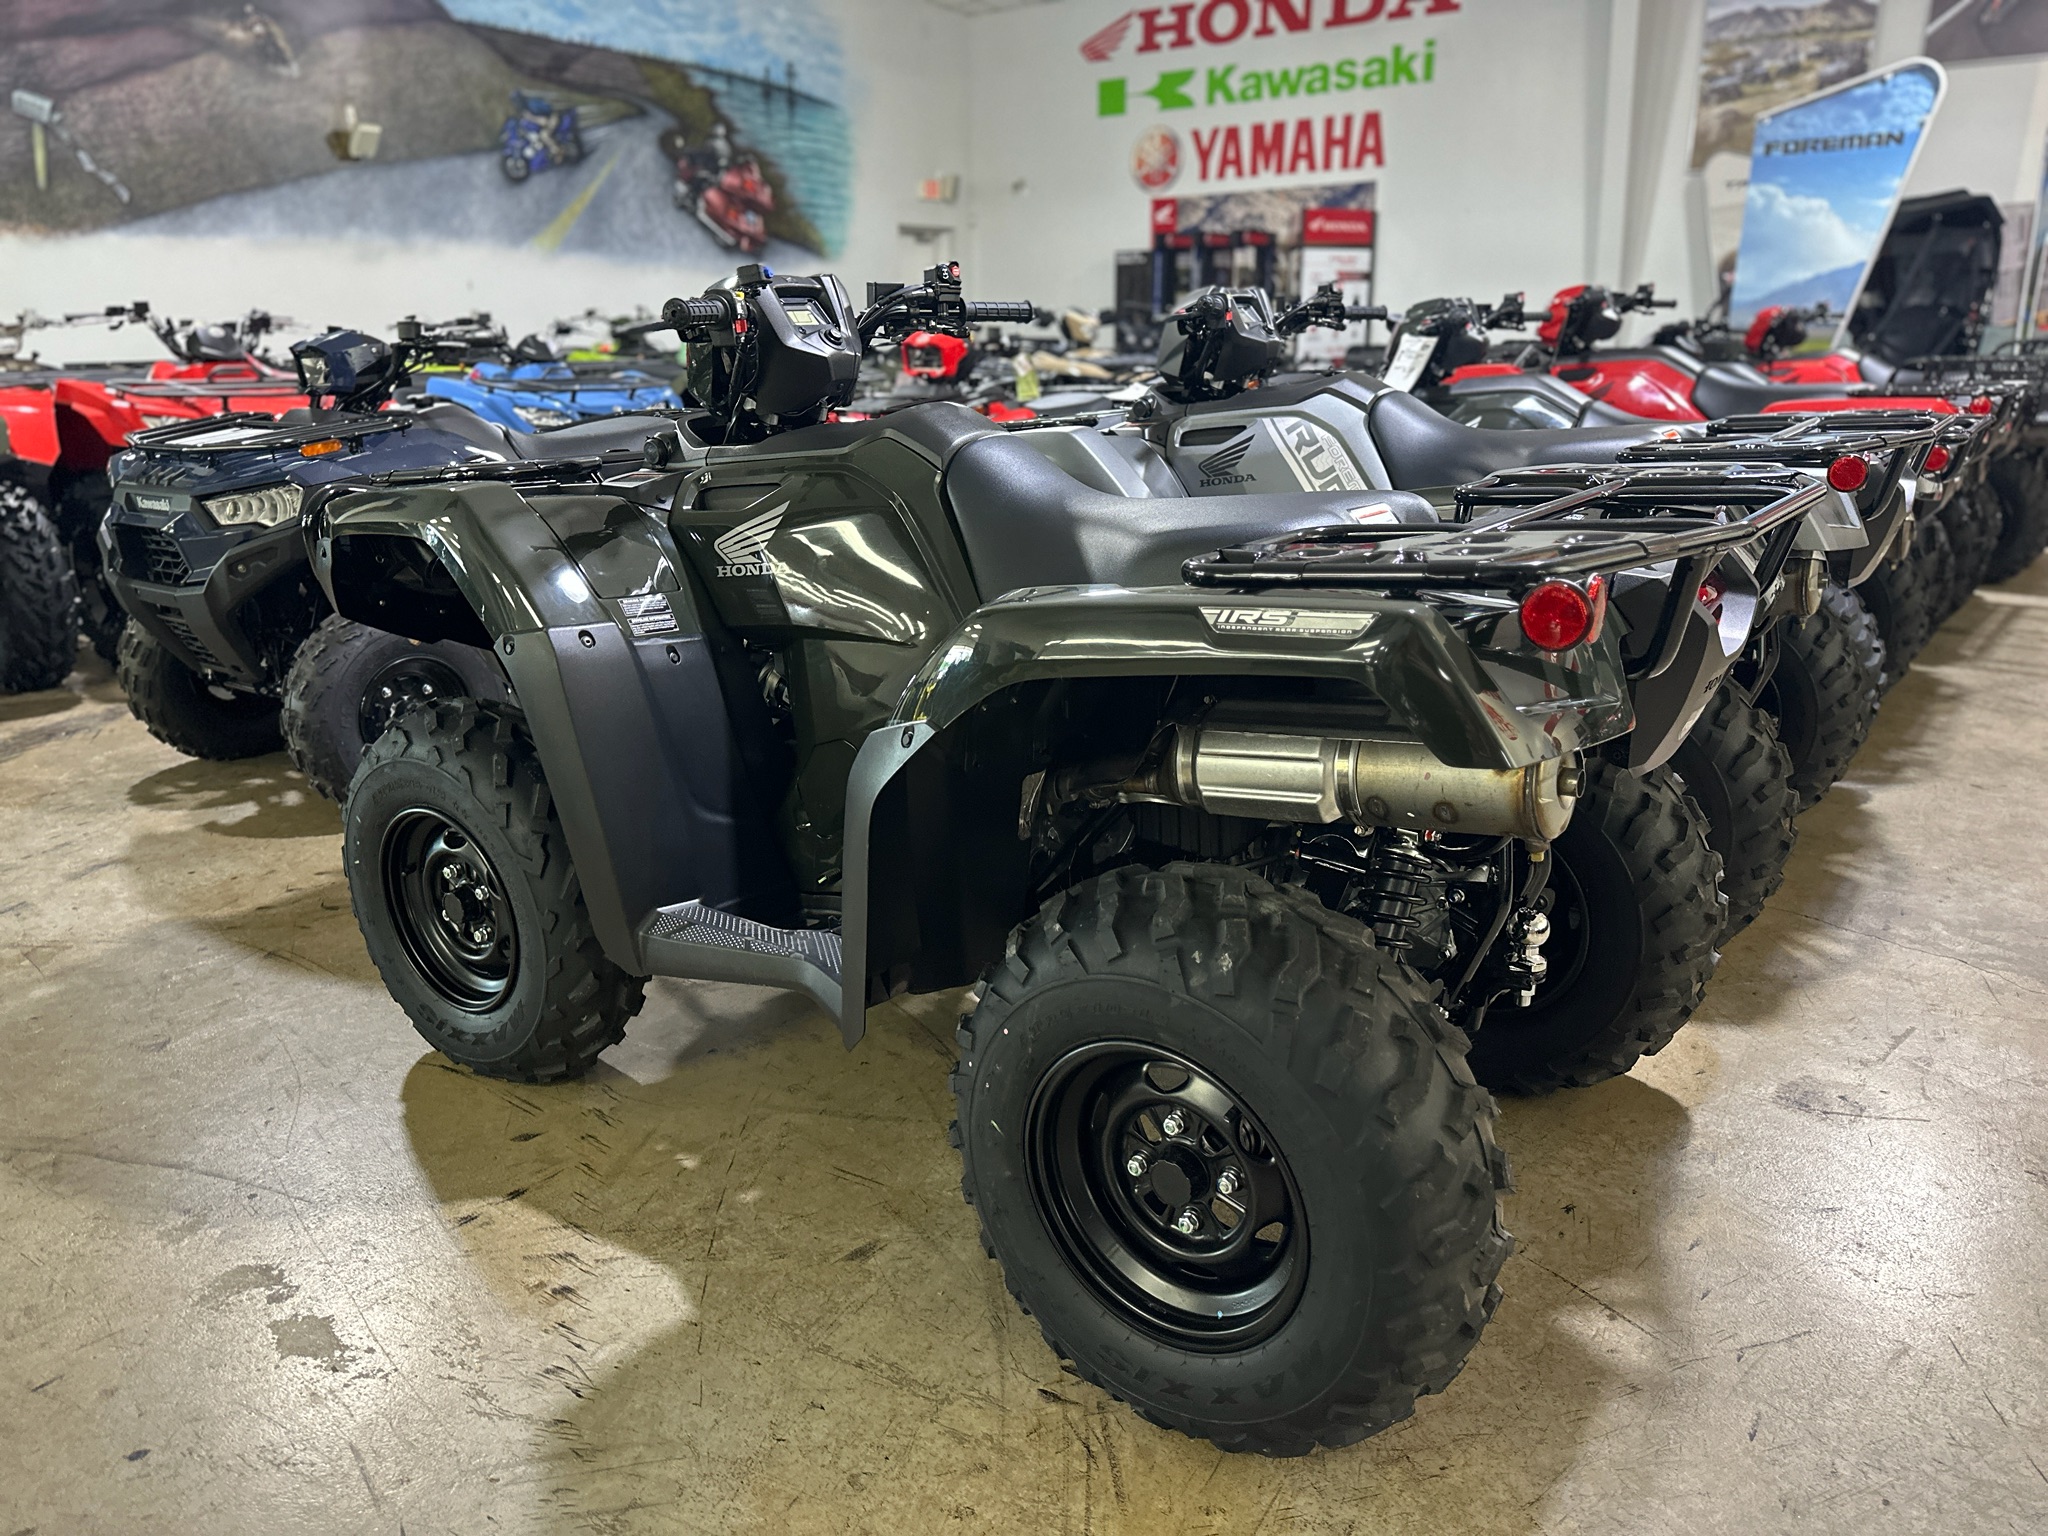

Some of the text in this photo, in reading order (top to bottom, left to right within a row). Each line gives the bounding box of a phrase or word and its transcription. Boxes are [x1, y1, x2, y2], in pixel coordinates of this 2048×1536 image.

[1205, 38, 1436, 106] Kawasaki
[1191, 110, 1385, 181] YAMAHA
[1764, 131, 1905, 157] FOREMAN
[1199, 473, 1257, 487] HONDA
[716, 561, 793, 577] HONDA
[1217, 609, 1292, 625] IRS
